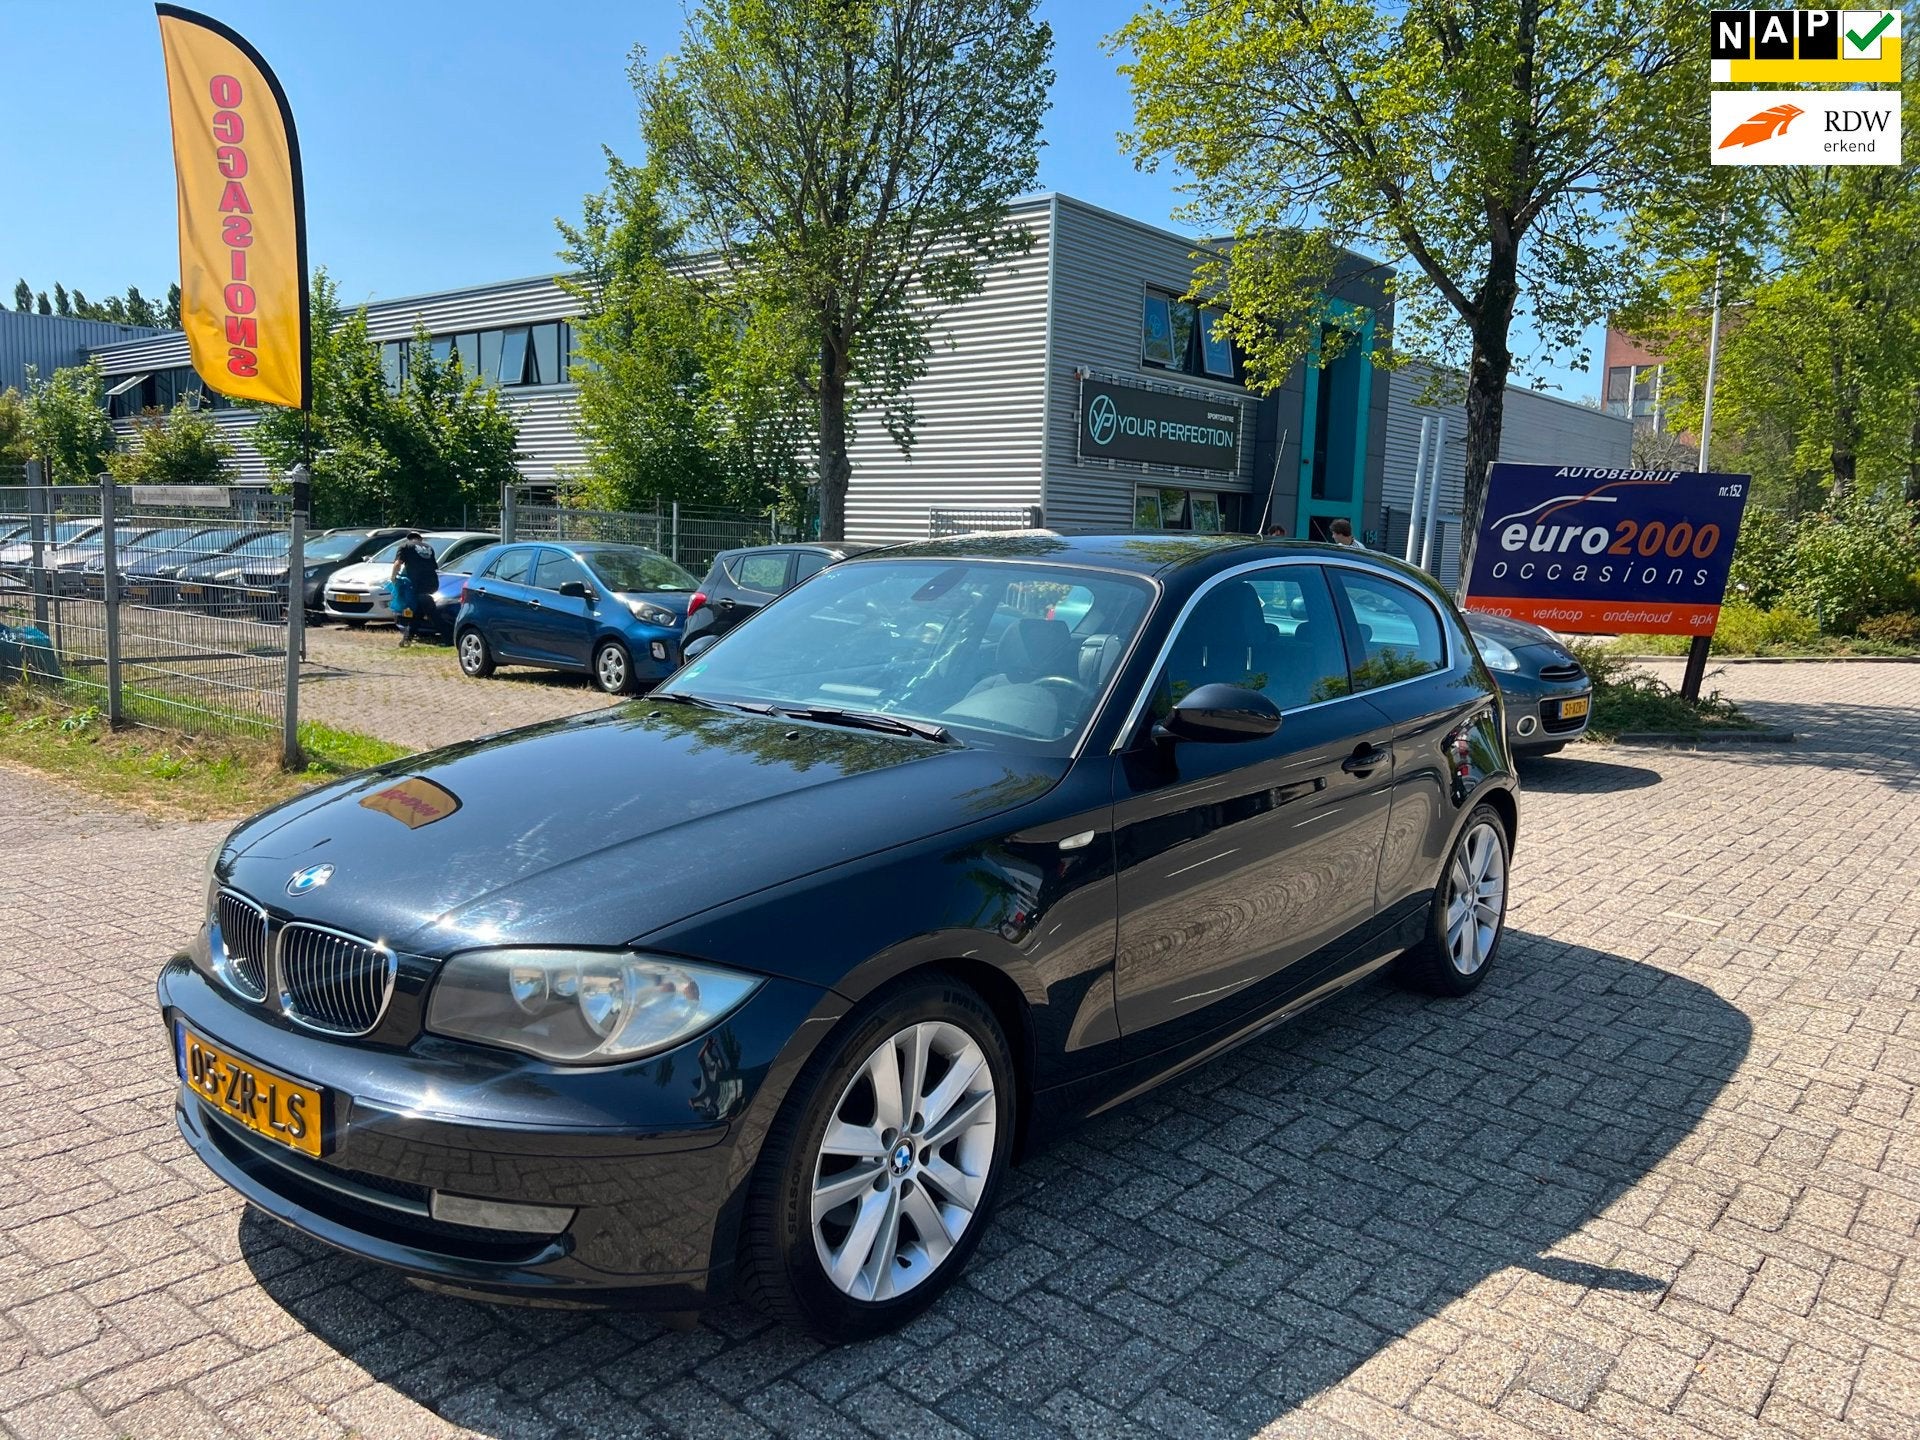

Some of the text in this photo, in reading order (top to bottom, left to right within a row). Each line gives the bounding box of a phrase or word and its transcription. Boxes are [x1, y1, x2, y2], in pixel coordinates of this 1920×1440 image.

[1117, 414, 1234, 447] YOUR PERFECTION
[1555, 466, 1681, 482] AUTOBEDRIJF
[1718, 484, 1742, 497] nr.152
[1500, 519, 1720, 559] euro2000
[1492, 560, 1708, 586] occasions
[1532, 608, 1583, 622] verkoop
[1602, 610, 1672, 624] onderhoud
[1689, 614, 1714, 627] apk
[191, 1043, 306, 1139] 05-ZR-LS
[788, 1160, 804, 1234] SEASON
